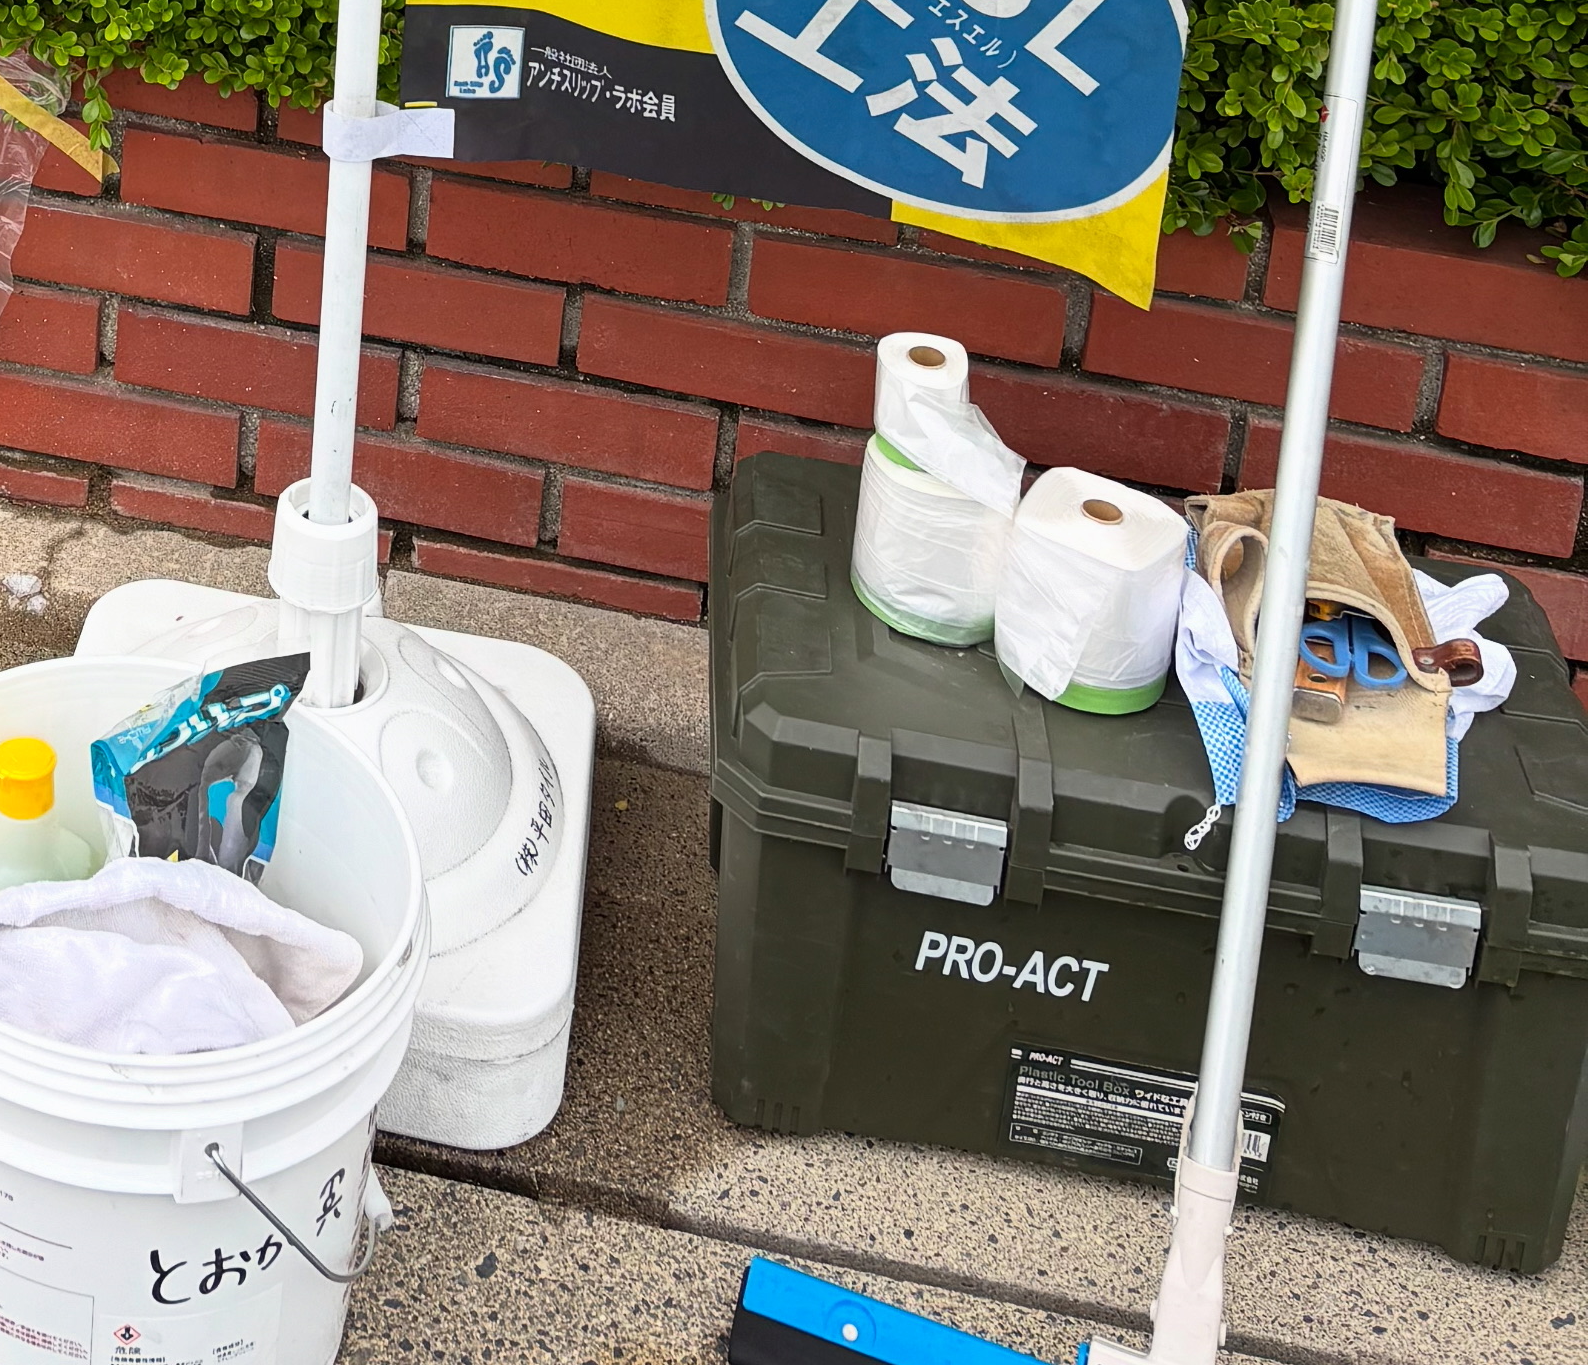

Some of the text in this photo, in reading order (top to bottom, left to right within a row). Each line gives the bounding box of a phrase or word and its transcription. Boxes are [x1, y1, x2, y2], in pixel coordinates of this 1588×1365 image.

[531, 46, 612, 79] 一般社団法人
[527, 62, 676, 122] アンチスリップ・ラボ会員
[915, 930, 1110, 1002] PRO-ACT
[1029, 1051, 1063, 1066] PRO-ACT
[1019, 1065, 1130, 1096] Plastic Tool Box
